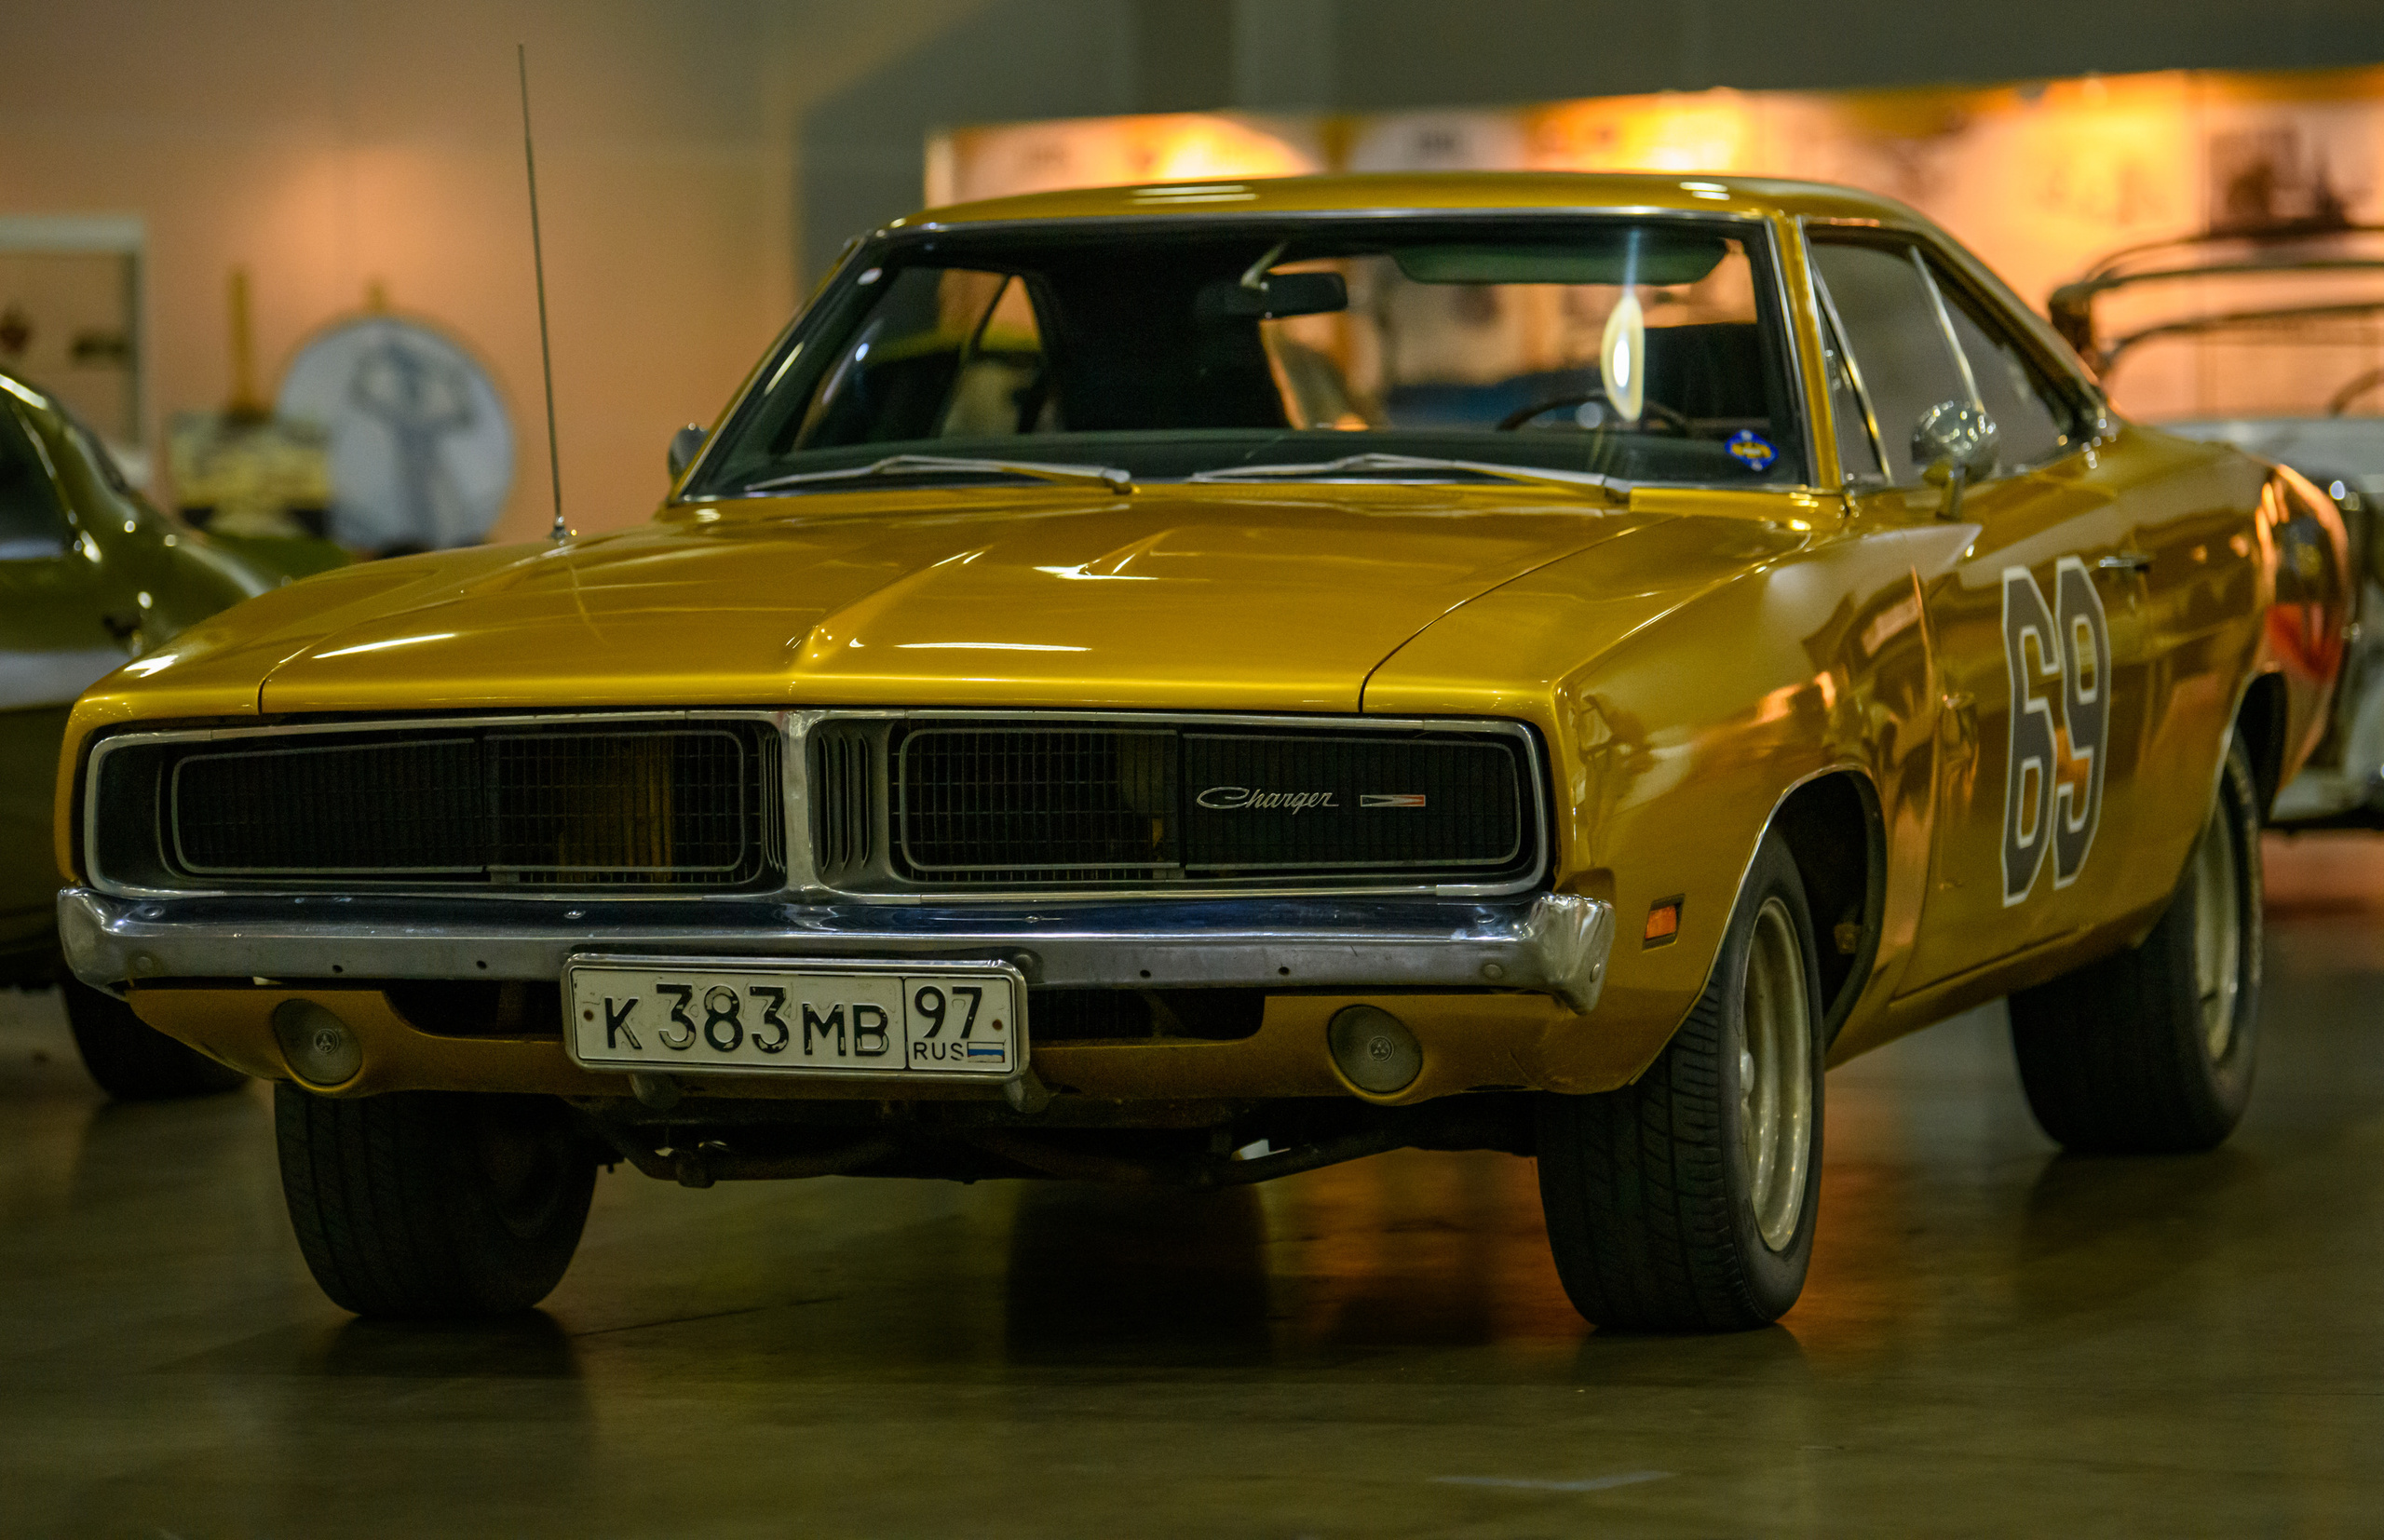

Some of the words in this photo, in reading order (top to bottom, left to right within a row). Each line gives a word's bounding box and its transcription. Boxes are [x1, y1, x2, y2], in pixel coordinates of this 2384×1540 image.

[2001, 556, 2110, 908] 69
[1197, 787, 1339, 816] Charger
[914, 986, 983, 1039] 97
[914, 1041, 965, 1061] RUS
